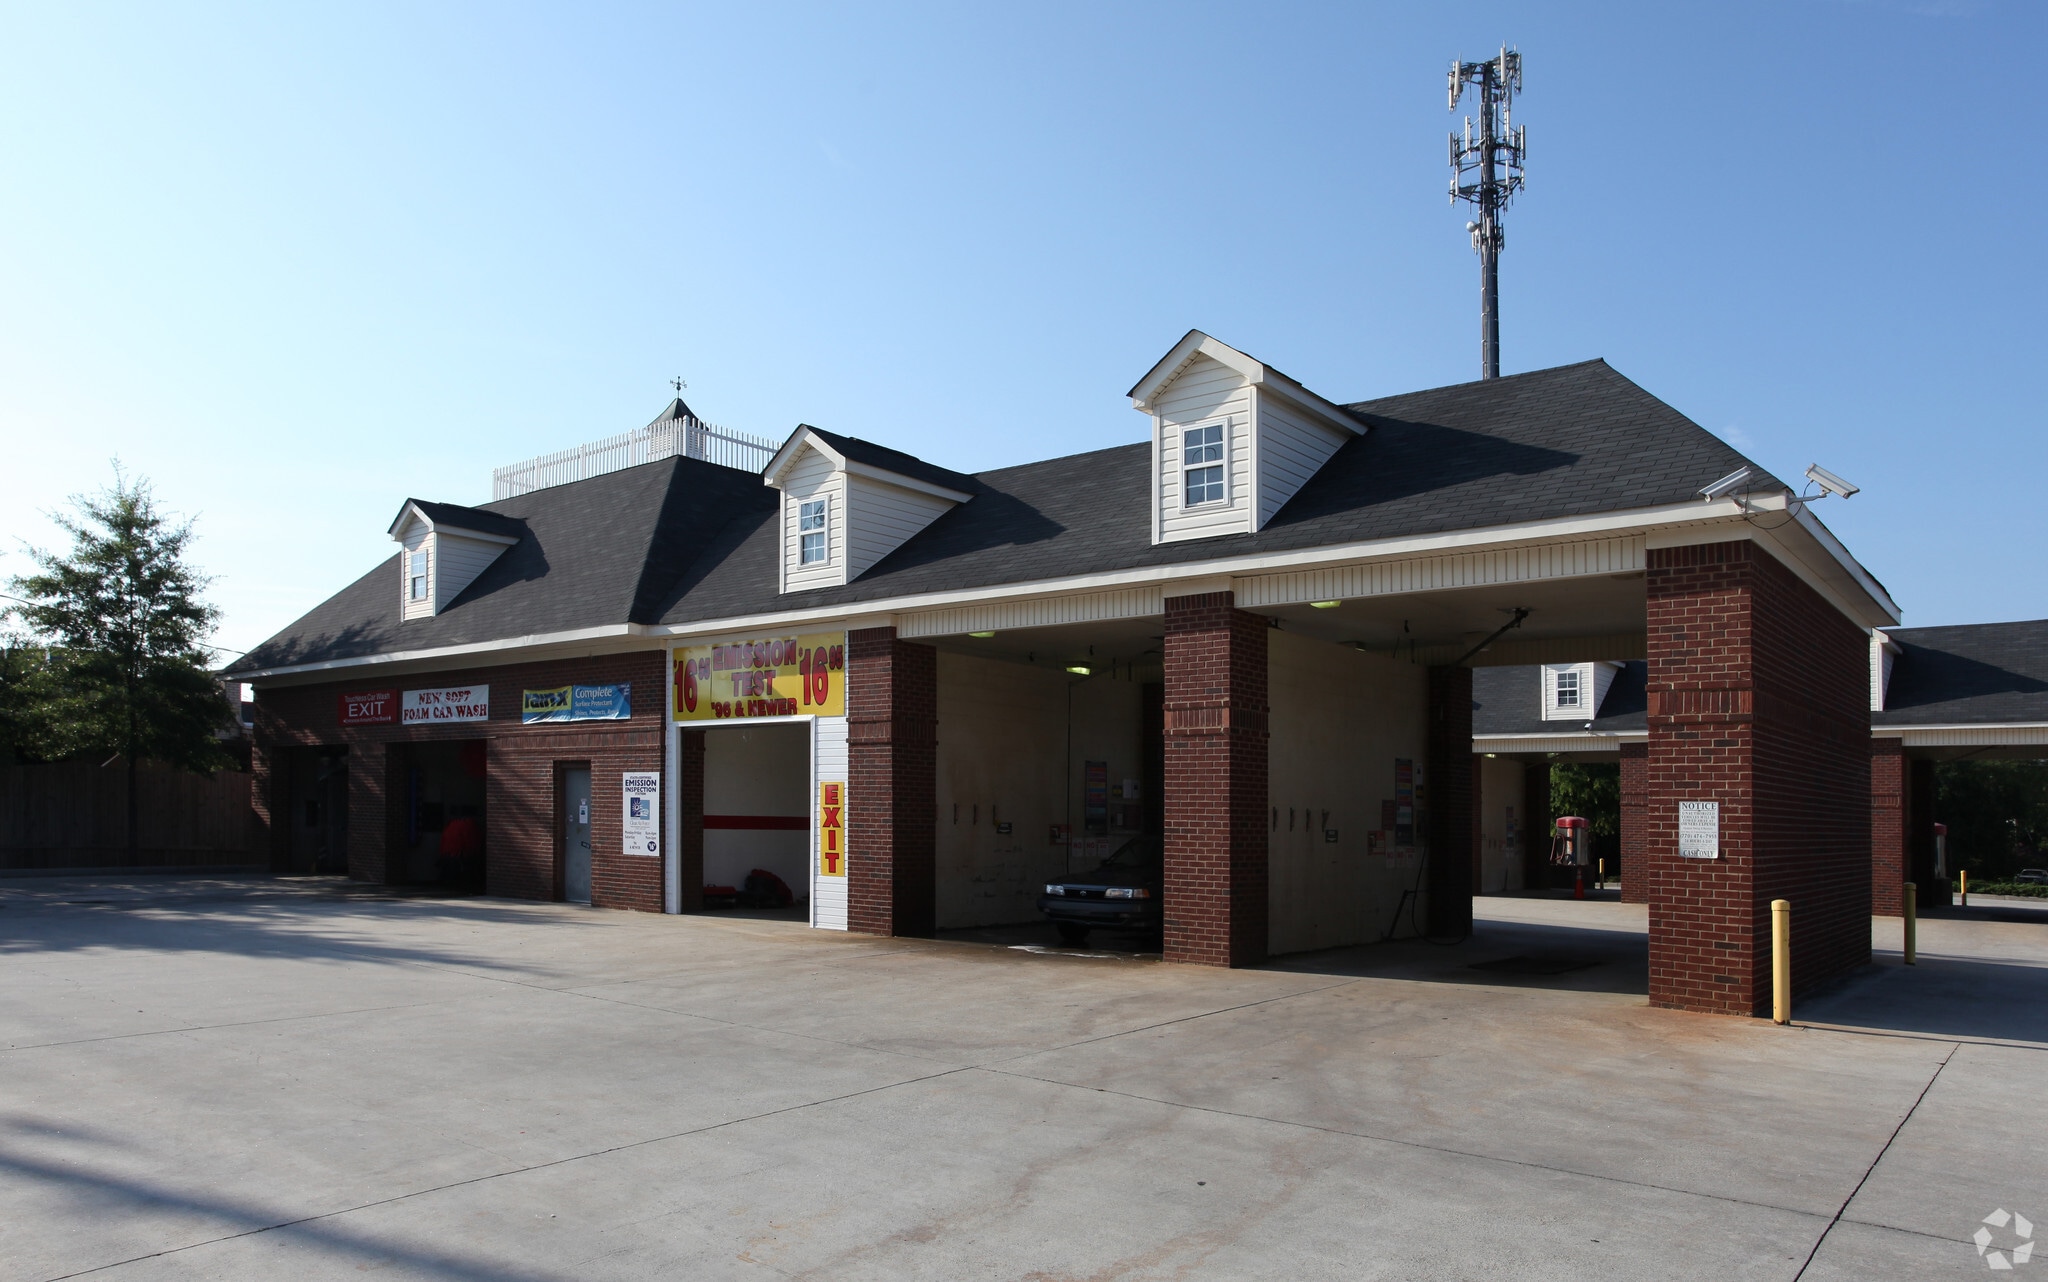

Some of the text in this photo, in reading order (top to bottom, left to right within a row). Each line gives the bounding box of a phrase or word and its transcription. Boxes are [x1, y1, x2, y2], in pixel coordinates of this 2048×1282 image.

[712, 640, 797, 672] EMISSION
[731, 669, 777, 698] TEST
[367, 693, 376, 702] Car
[376, 692, 391, 701] Wash
[418, 690, 472, 705] NEW SOFT
[575, 686, 613, 700] Complete
[348, 701, 385, 718] EXIT
[403, 704, 488, 721] FOAM CAR WASH
[735, 700, 745, 717] &
[747, 697, 798, 717] NEWER
[1682, 802, 1717, 810] NOTICE
[822, 784, 842, 874] EXIT
